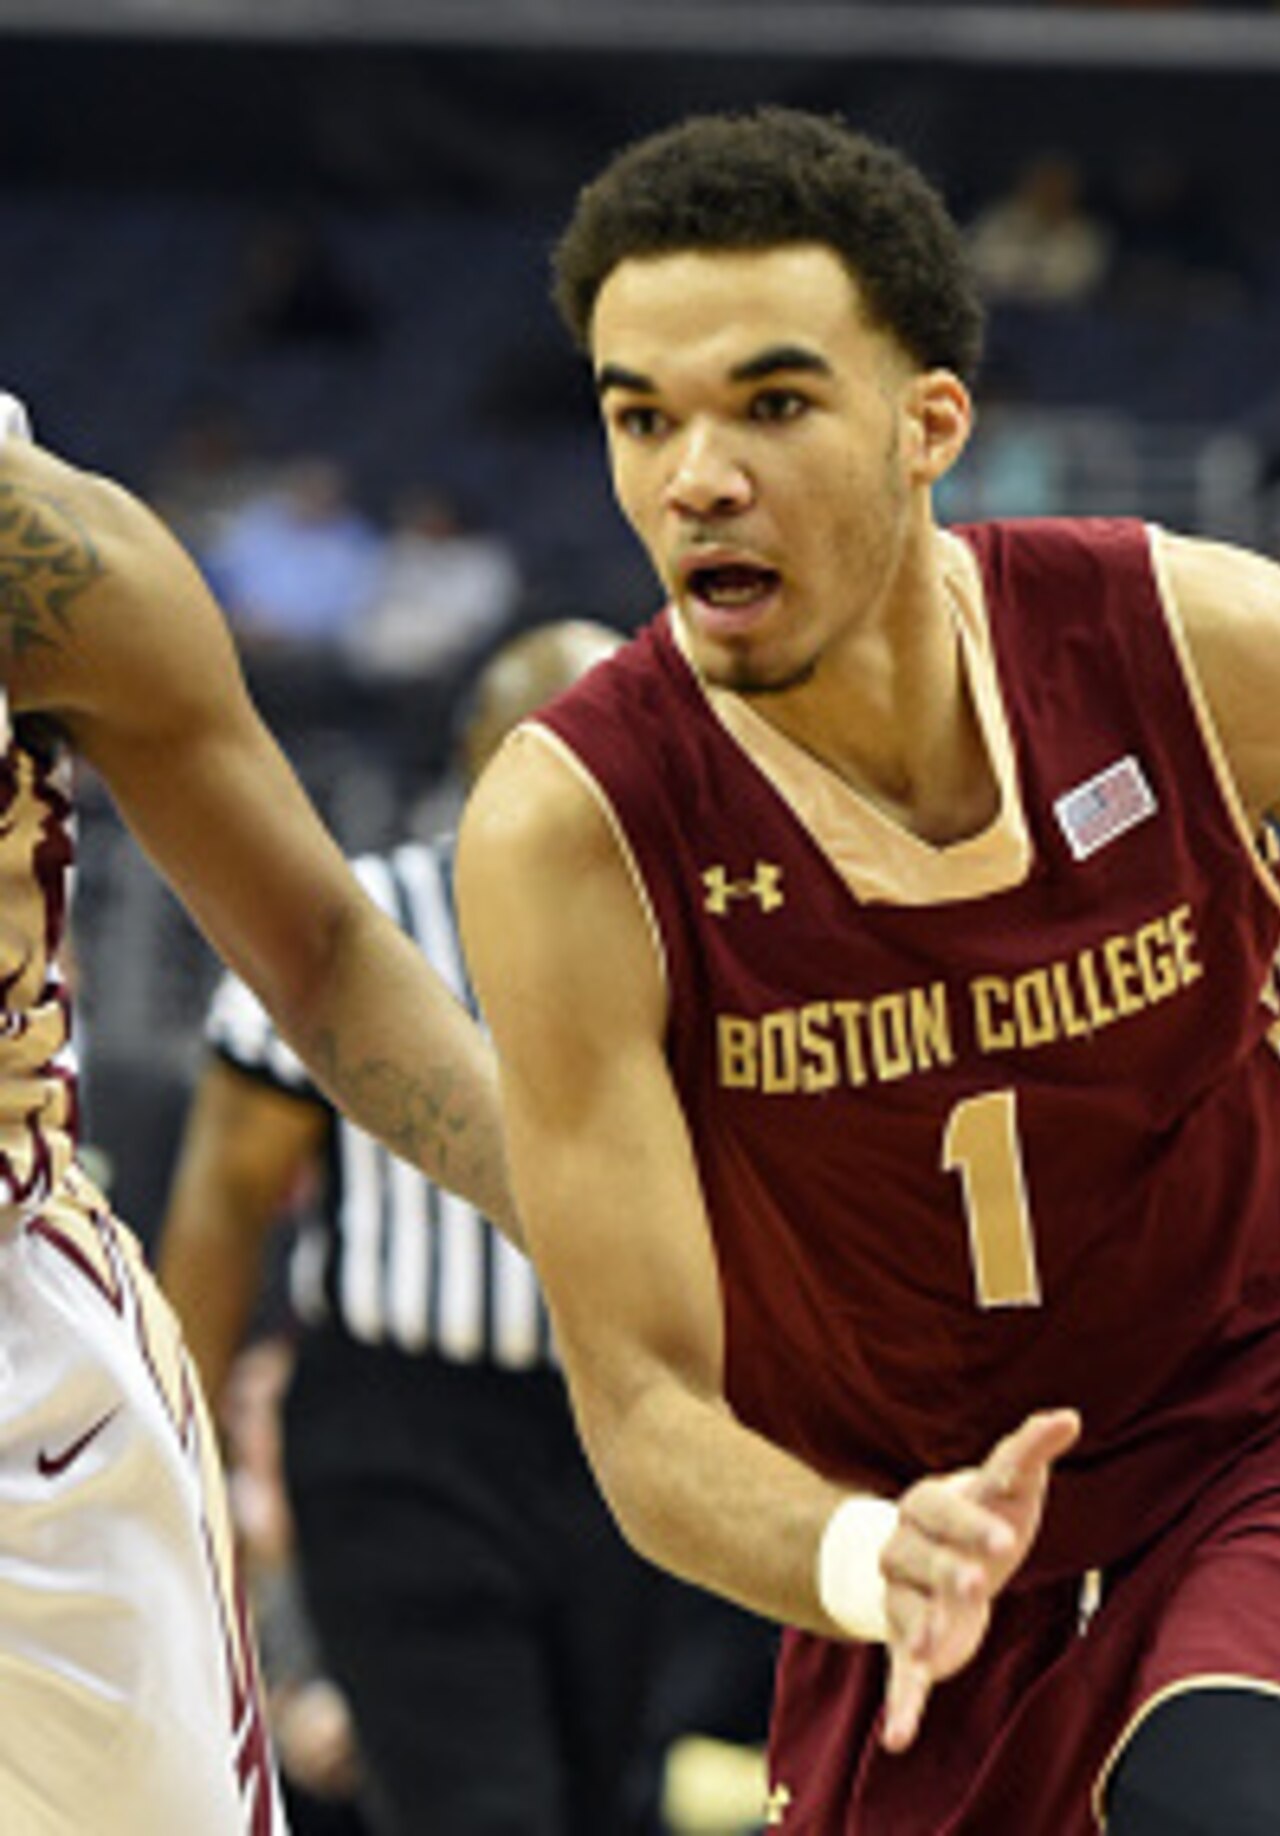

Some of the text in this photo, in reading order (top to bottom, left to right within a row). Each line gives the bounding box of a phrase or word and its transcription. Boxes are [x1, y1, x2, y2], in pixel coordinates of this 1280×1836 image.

[716, 981, 955, 1094] BOSTON
[971, 904, 1203, 1052] COLLEGE
[940, 1089, 1043, 1309] 1
